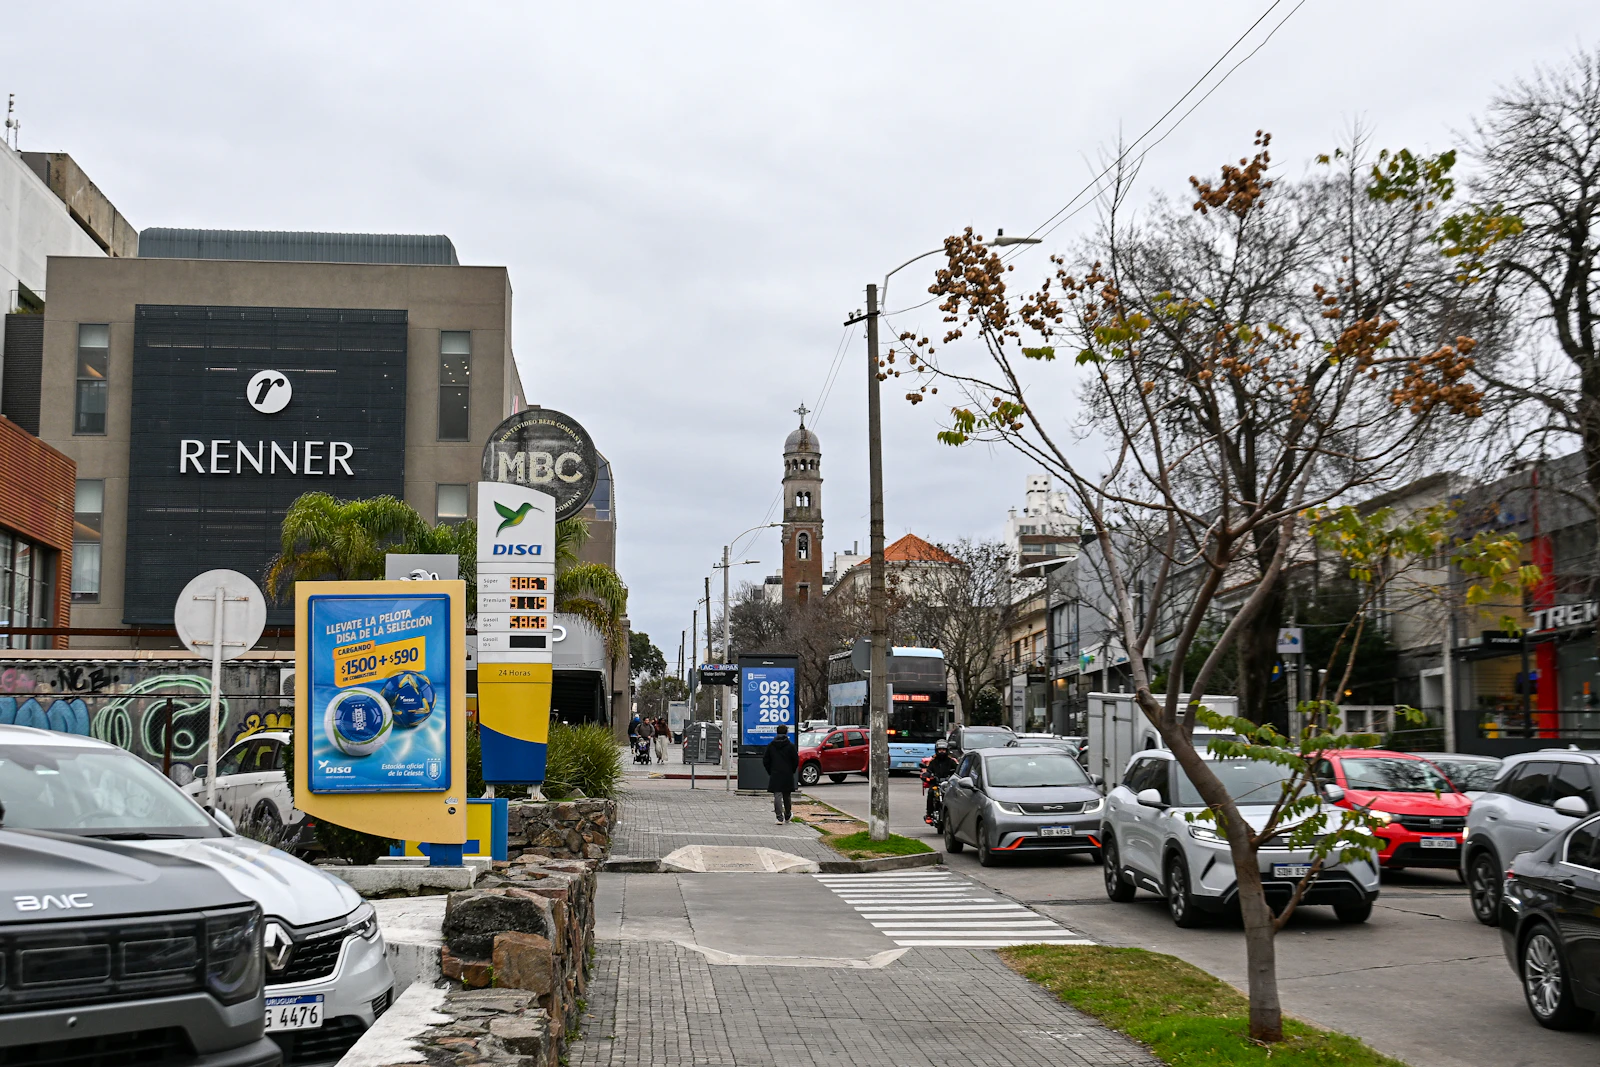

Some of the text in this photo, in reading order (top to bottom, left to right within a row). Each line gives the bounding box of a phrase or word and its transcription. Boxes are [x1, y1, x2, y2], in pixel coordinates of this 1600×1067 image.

[499, 419, 537, 444] MONTEVIDEO
[556, 422, 582, 444] COMPANY
[179, 439, 354, 475] RENNER
[497, 451, 583, 483] MBC
[555, 491, 581, 513] COMPANY
[326, 609, 412, 635] LLEVATE LA PELOTA
[336, 615, 432, 644] DISA DE LA SELECCIÓN
[338, 643, 371, 656] CARGANDO
[341, 655, 377, 675] $1500
[389, 647, 419, 666] $590
[759, 681, 790, 695] 092
[760, 695, 790, 709] 250
[760, 709, 790, 723] 260
[326, 766, 352, 774] DISA
[406, 763, 424, 771] oficial
[13, 893, 94, 911] BAIC
[280, 1005, 318, 1027] 4476
